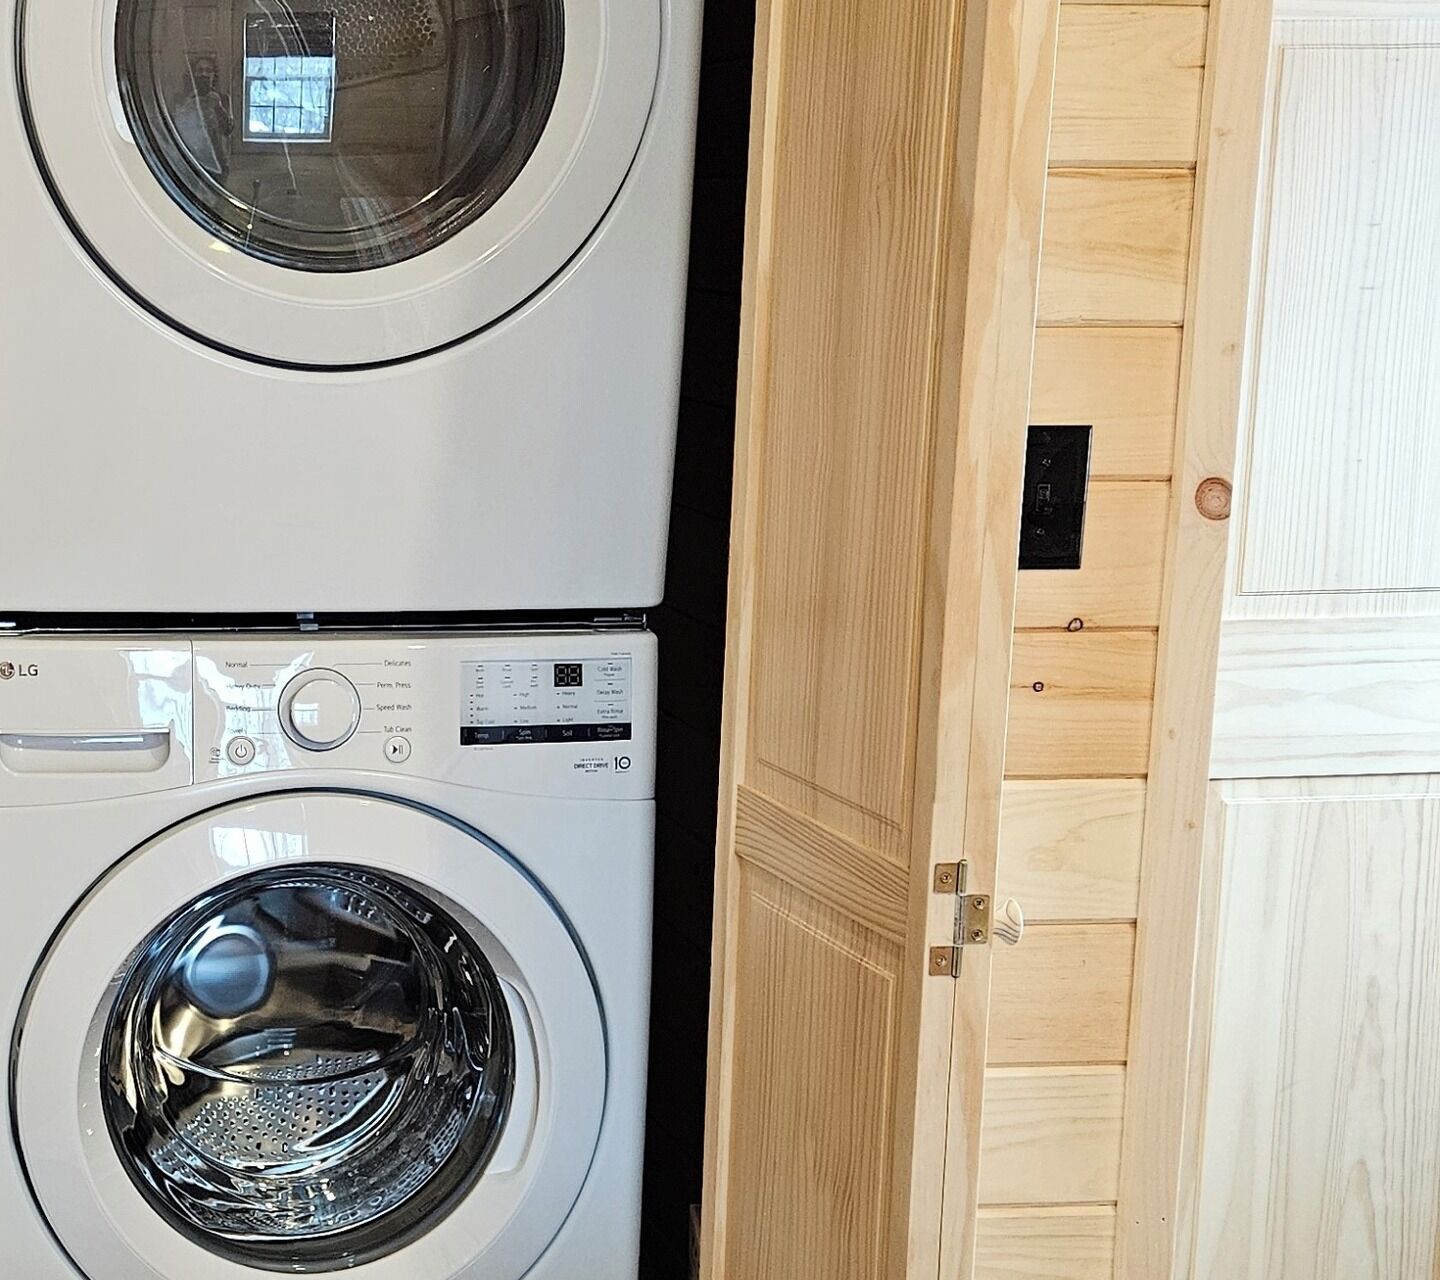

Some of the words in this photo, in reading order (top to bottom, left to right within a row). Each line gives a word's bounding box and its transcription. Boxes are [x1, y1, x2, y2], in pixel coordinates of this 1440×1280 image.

[19, 664, 39, 676] LG
[376, 703, 395, 712] Speed
[562, 729, 573, 737] Soil
[614, 756, 631, 770] 10
